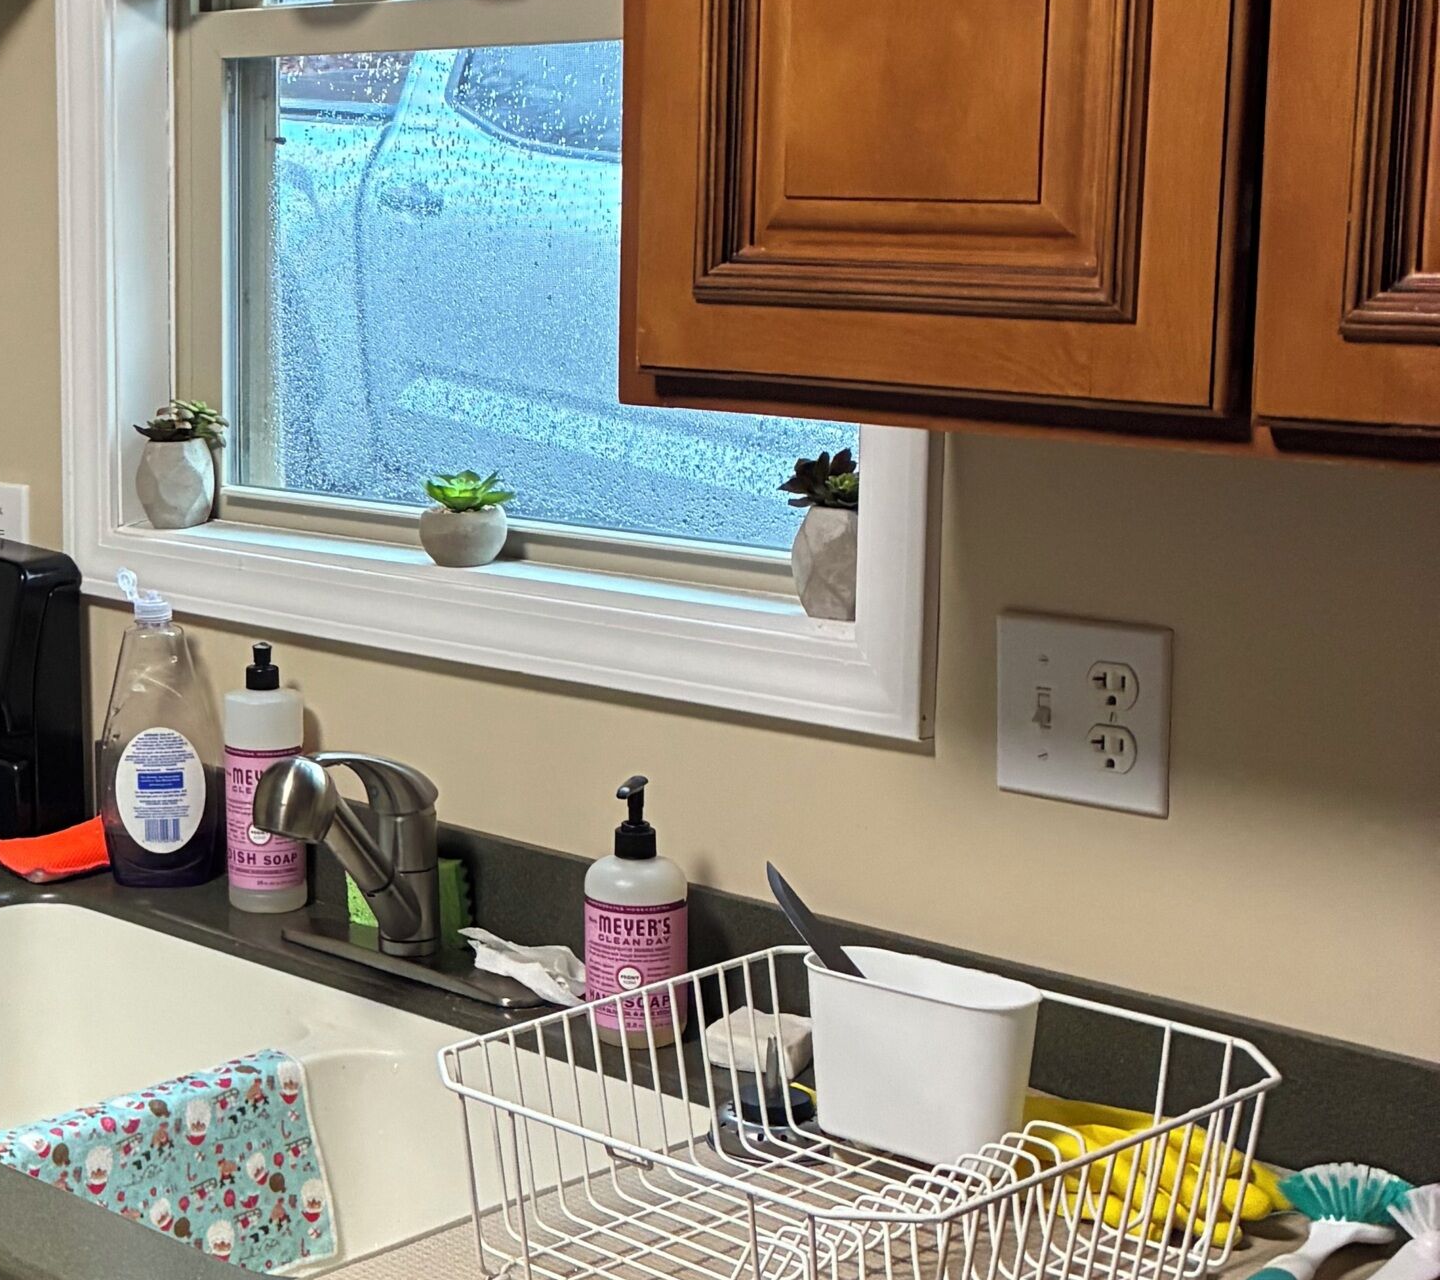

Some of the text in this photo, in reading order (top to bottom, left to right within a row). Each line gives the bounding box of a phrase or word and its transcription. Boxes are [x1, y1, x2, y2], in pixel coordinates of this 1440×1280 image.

[227, 850, 298, 866] DISH SOAP
[598, 914, 671, 937] MEYER'S
[597, 933, 670, 946] CLEAN DAY
